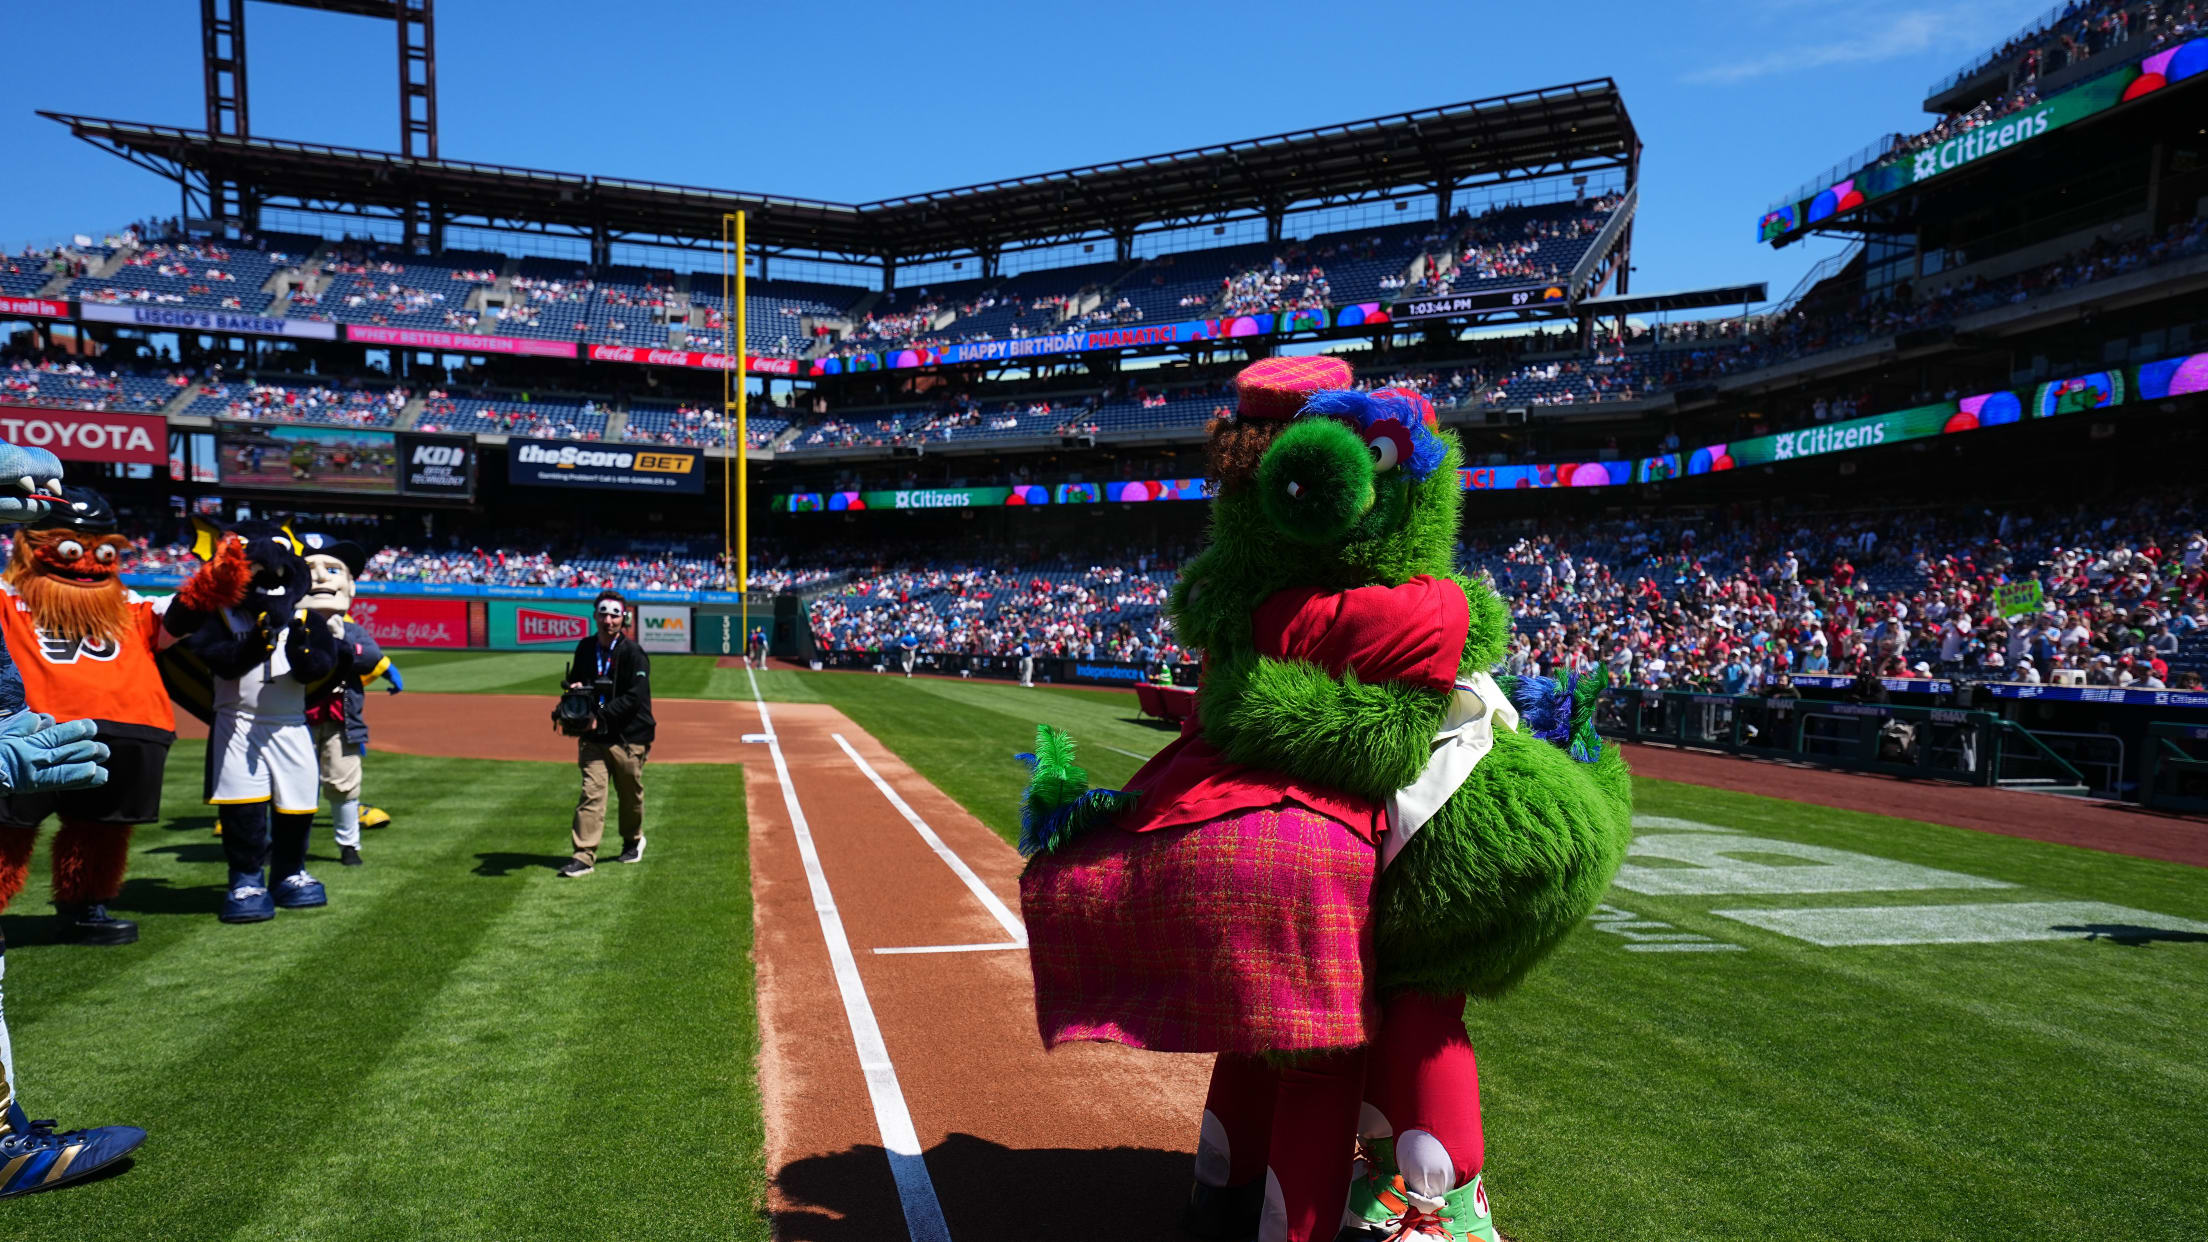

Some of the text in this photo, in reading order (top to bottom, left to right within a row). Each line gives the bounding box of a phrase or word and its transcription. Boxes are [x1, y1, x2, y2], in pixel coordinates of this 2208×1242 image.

[1939, 107, 2048, 169] Citizens
[12, 301, 39, 313] roll
[41, 303, 56, 315] in
[1409, 299, 1472, 315] 1:03:44 PM
[135, 308, 286, 332] LISCIO'S BAKERY
[354, 328, 396, 342] WHEY
[401, 331, 450, 346] BETTER
[454, 335, 512, 350] PROTEIN
[959, 325, 1177, 361] HAPPY BIRTHDAY PHANATIC!
[594, 345, 635, 362] Coca-Cola
[648, 349, 688, 366] Coca-Cola
[753, 357, 792, 373] Coca-Cola
[0, 418, 154, 452] TOYOTA
[1796, 420, 1885, 457] Citizens
[412, 445, 465, 466] KDI
[518, 445, 690, 471] theScore BET
[910, 490, 970, 507] Citizens
[644, 617, 684, 630] WM
[722, 615, 730, 654] 330
